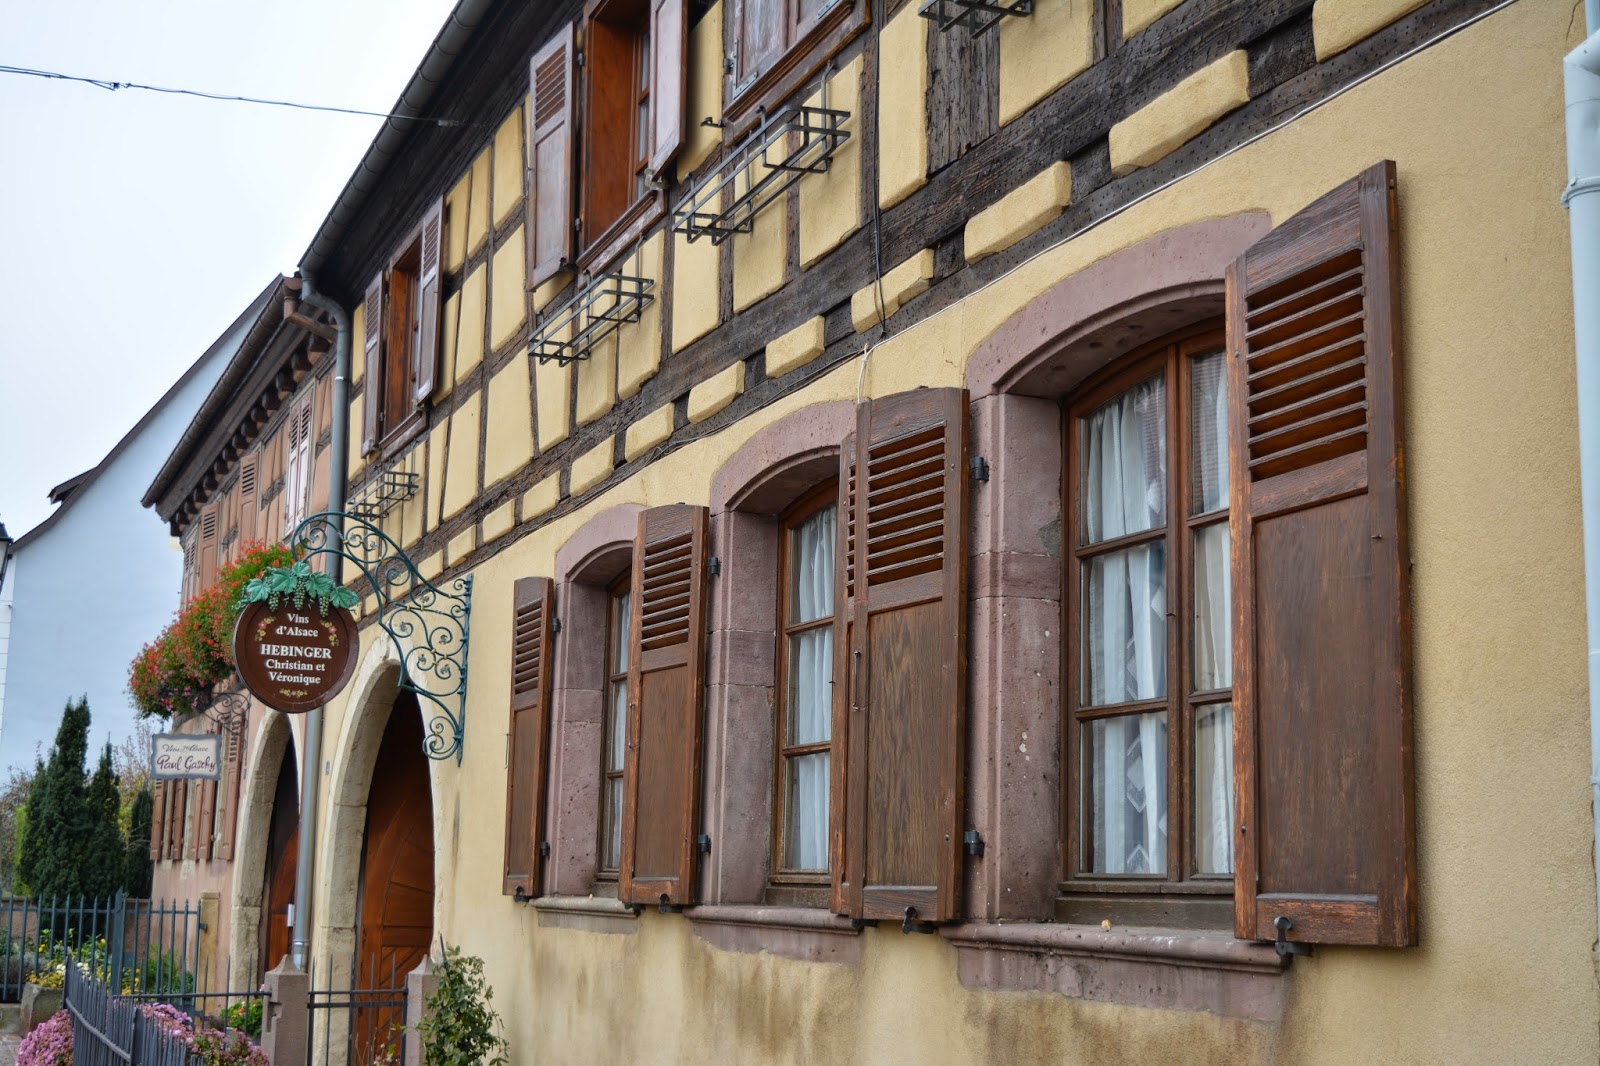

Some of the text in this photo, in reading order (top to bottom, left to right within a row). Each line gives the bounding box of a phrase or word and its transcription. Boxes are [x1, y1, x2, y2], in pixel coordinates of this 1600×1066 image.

[287, 613, 310, 624] Vins
[275, 625, 319, 637] d'Alsace
[260, 643, 332, 659] HEBINGER
[265, 658, 326, 671] Christian et
[268, 671, 321, 685] Véronique
[156, 754, 182, 771] Paul
